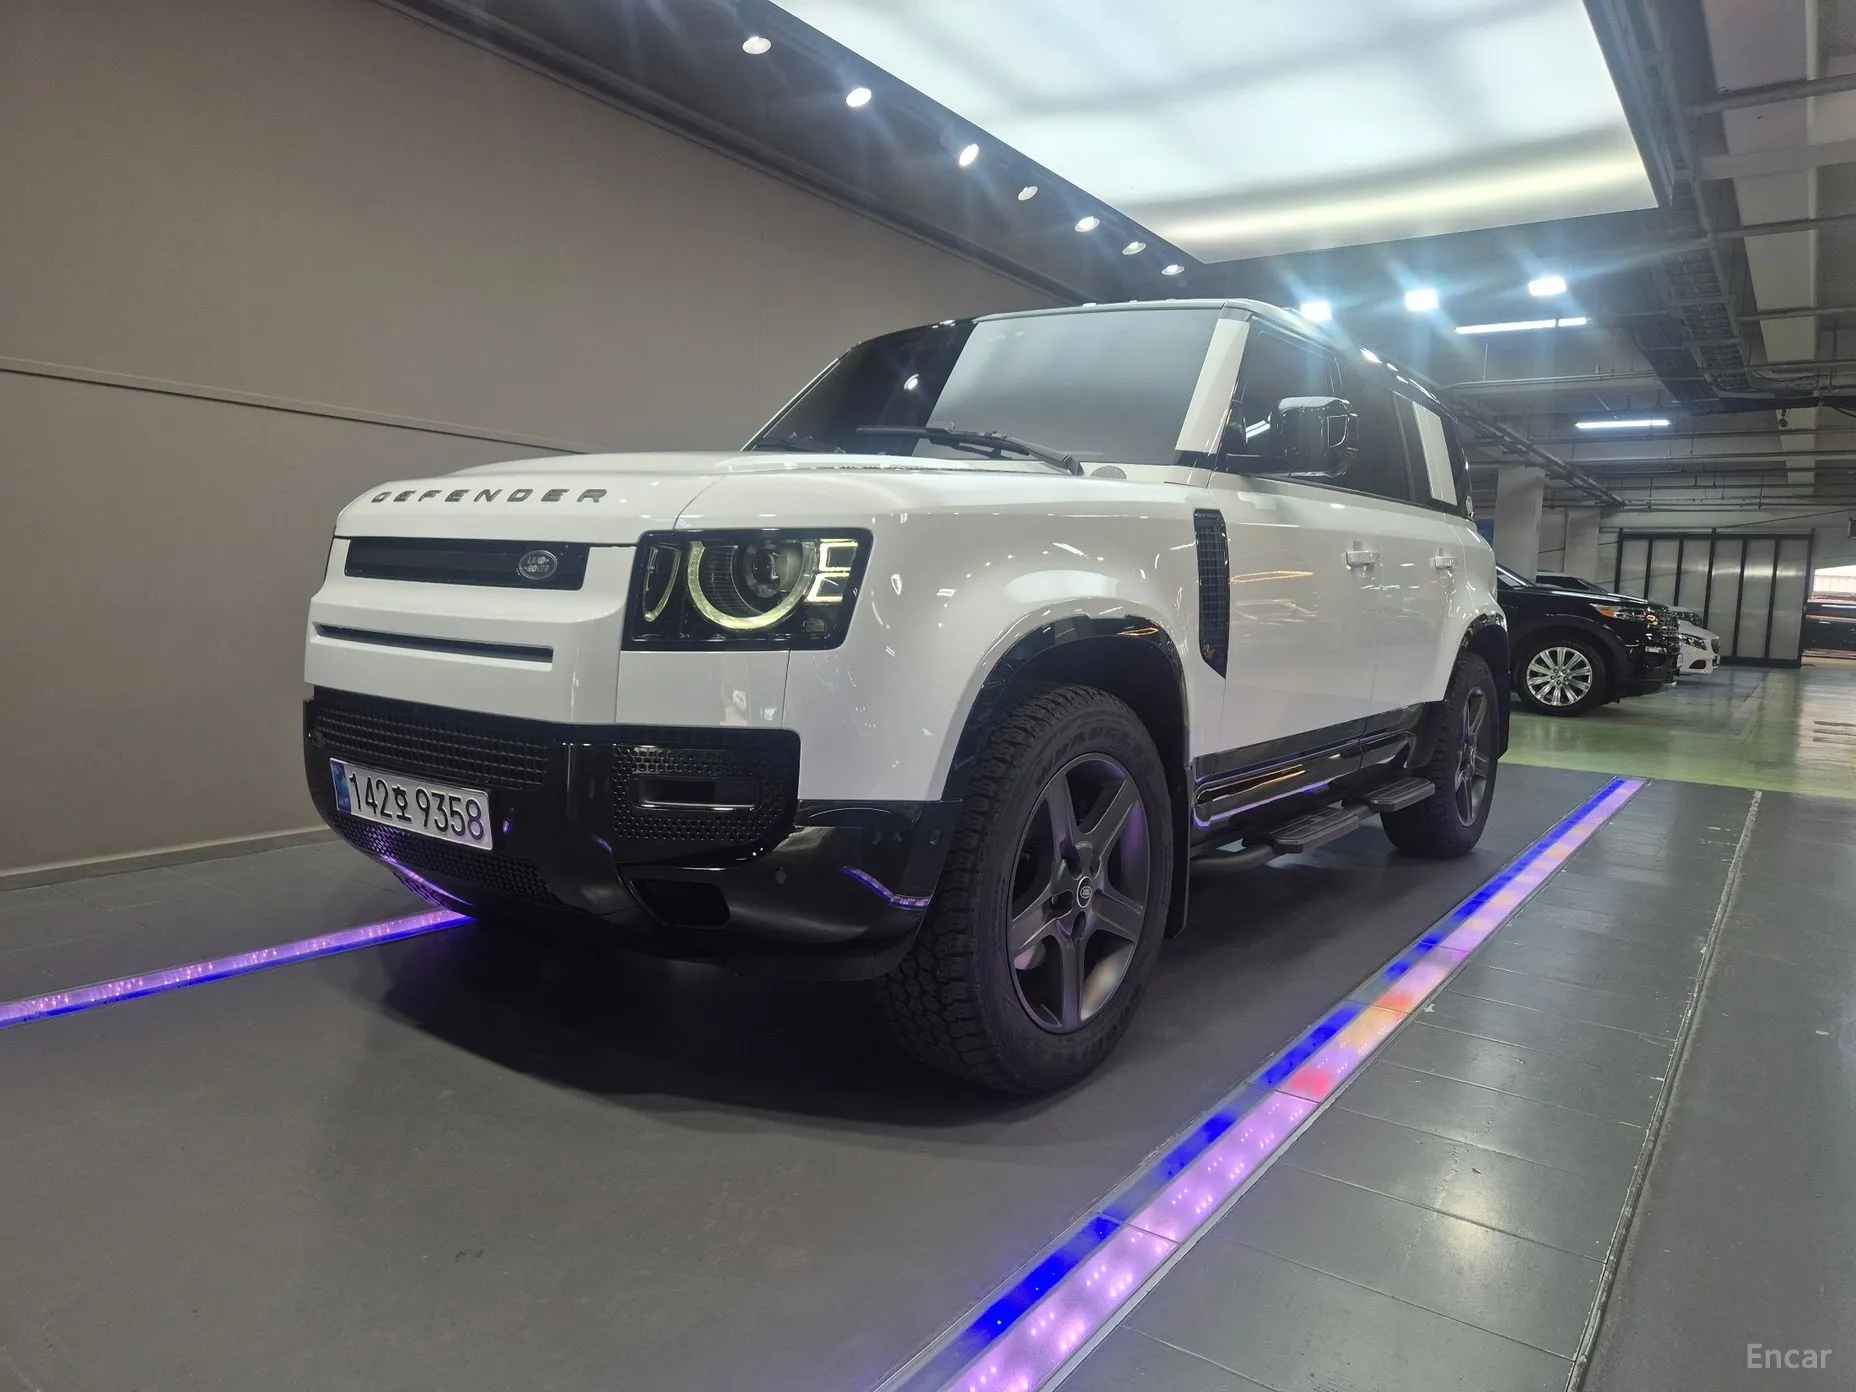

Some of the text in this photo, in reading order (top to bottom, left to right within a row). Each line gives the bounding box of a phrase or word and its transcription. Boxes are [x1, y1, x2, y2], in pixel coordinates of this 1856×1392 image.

[371, 488, 607, 503] DEFENDER
[349, 773, 484, 840] 142호 9358
